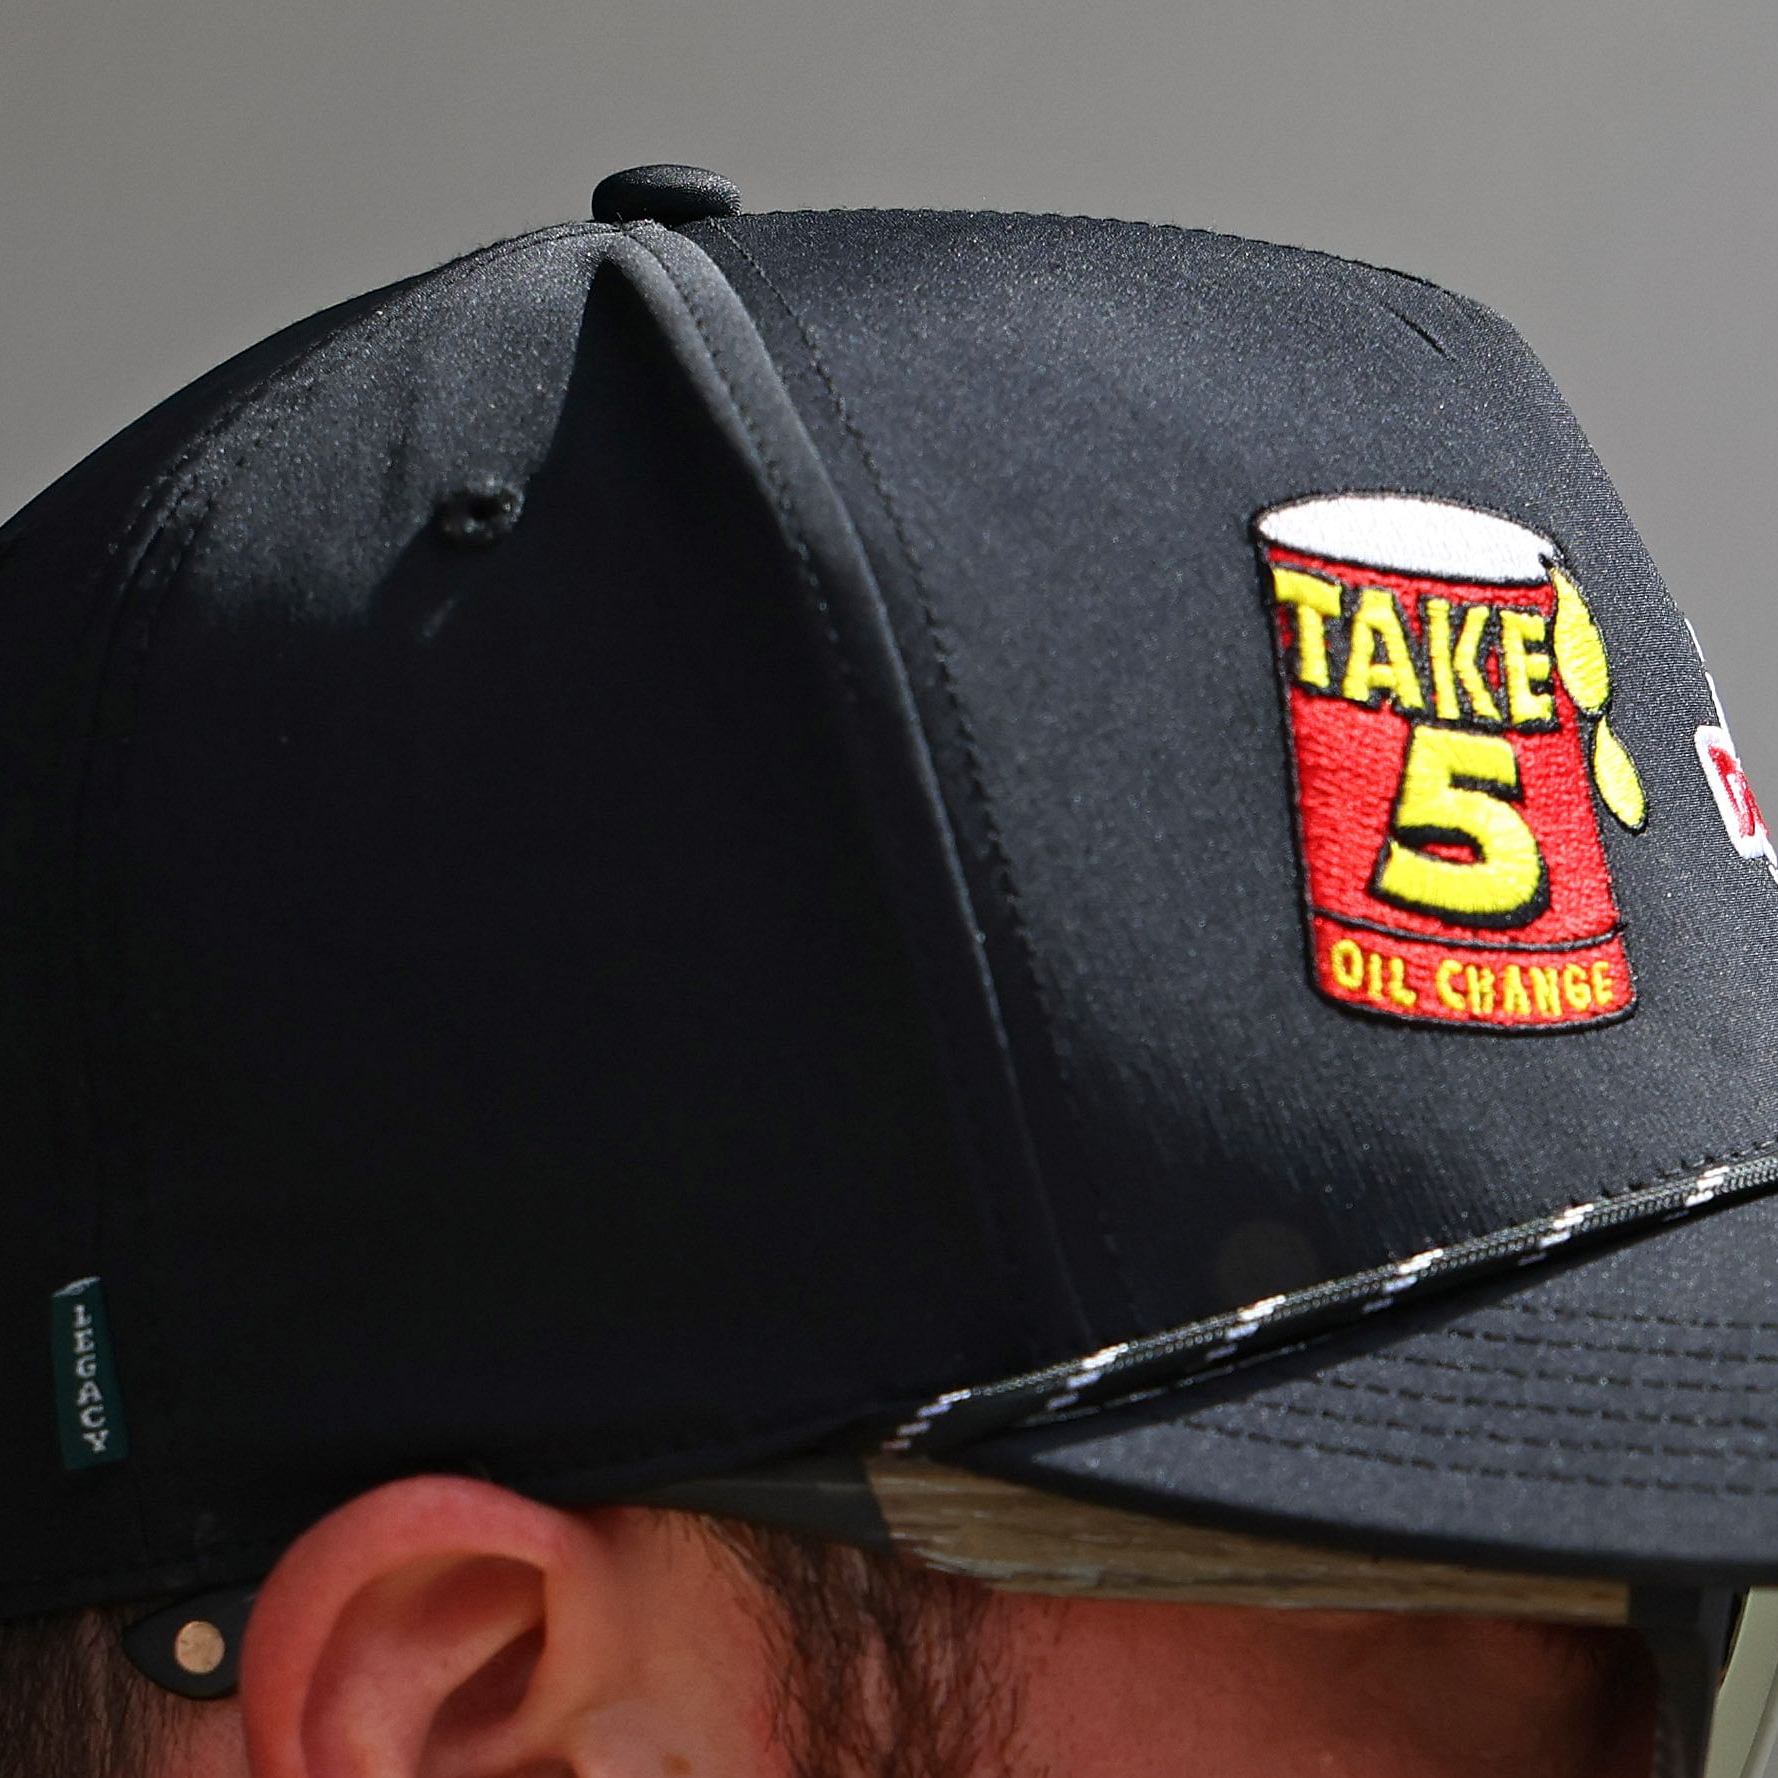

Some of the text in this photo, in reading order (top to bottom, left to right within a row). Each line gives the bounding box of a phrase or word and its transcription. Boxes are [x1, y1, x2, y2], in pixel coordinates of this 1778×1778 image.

[1272, 567, 1554, 723] TAKE
[1379, 725, 1542, 916] 5
[1331, 938, 1615, 1016] OIL CHANGE
[74, 1304, 110, 1453] LEGACY
